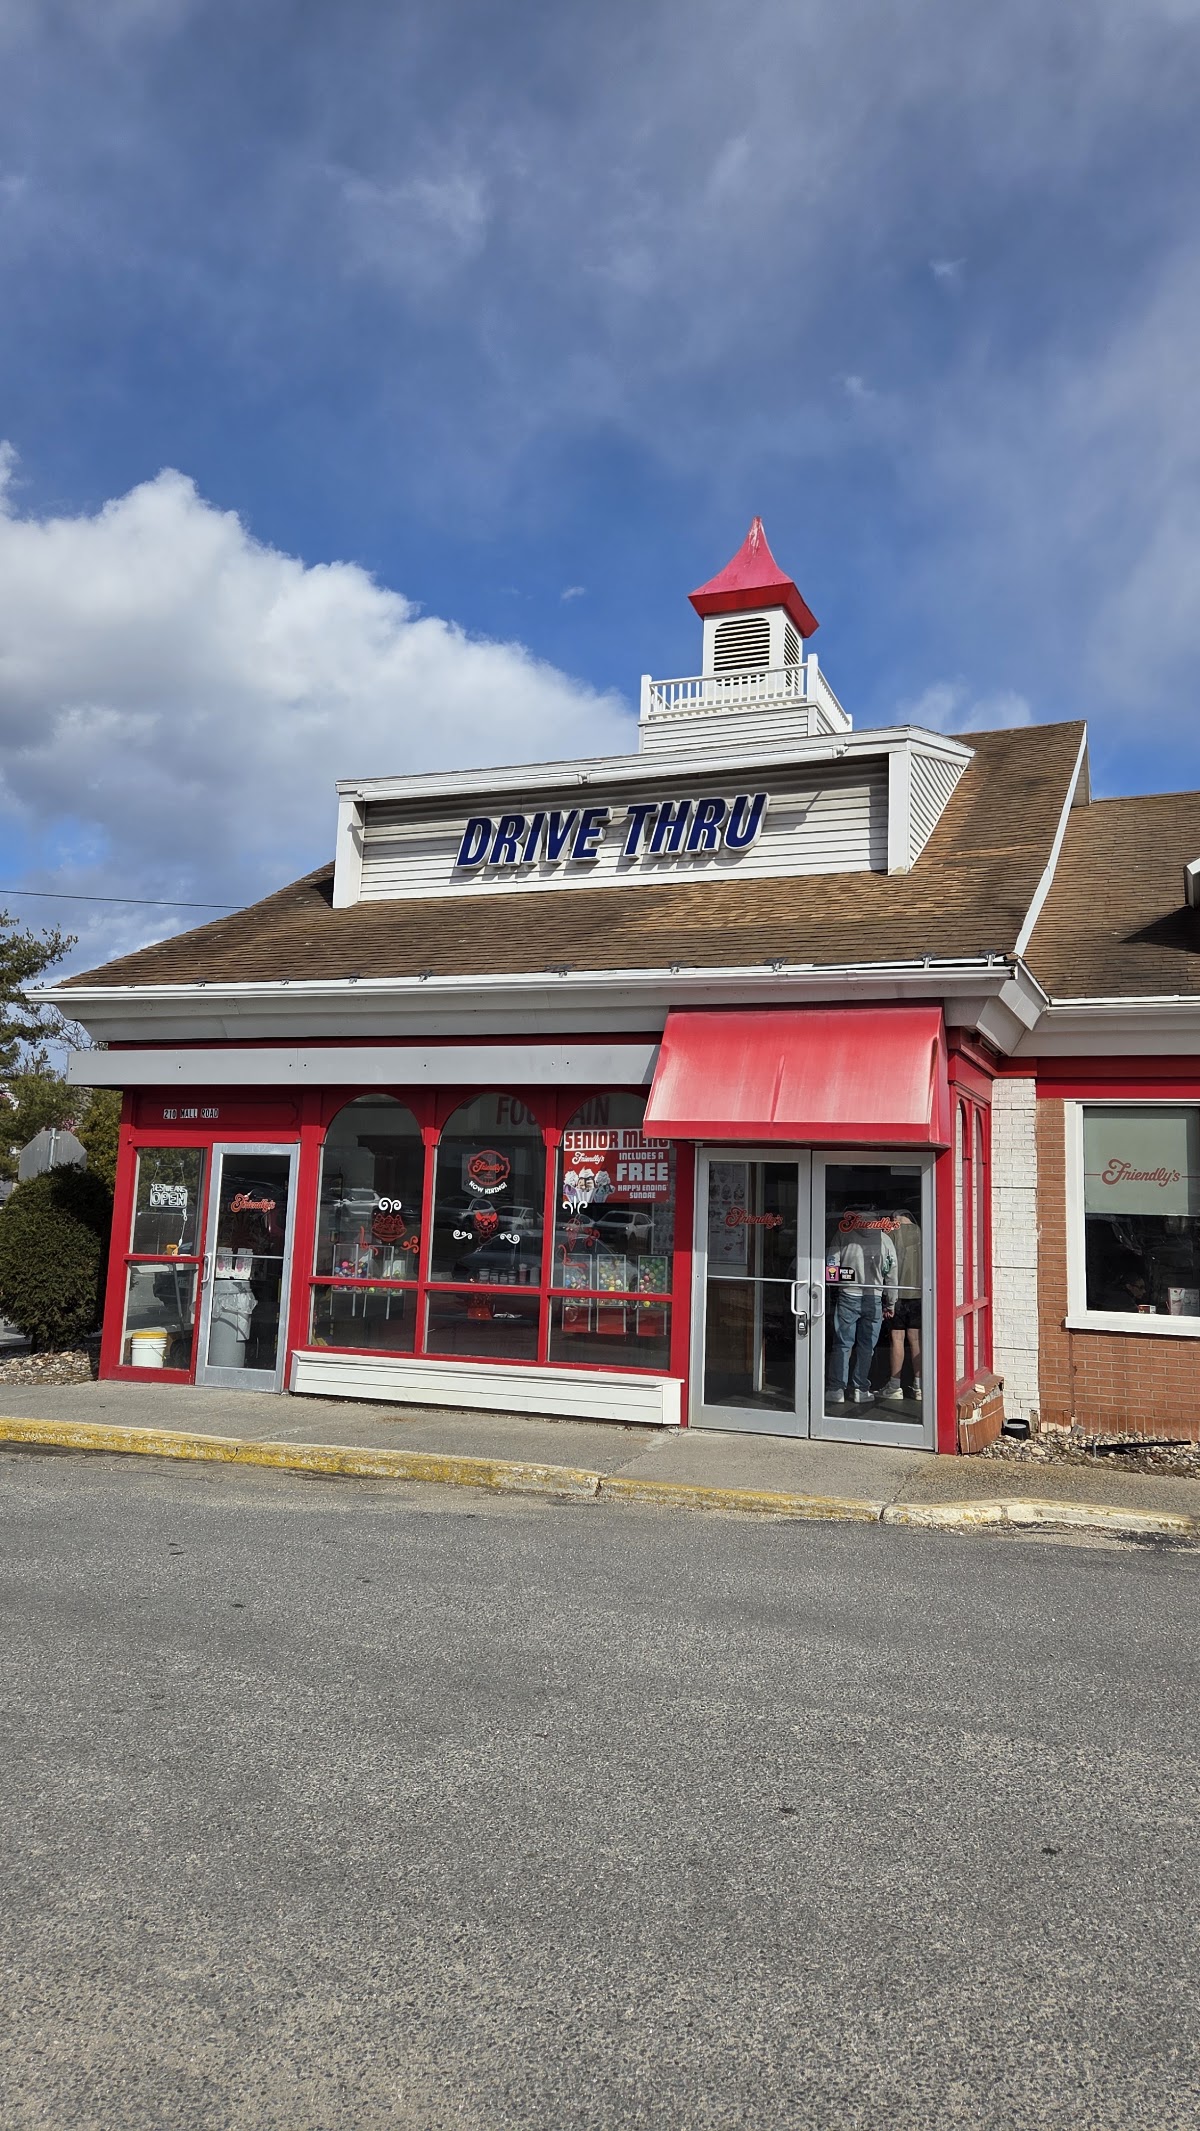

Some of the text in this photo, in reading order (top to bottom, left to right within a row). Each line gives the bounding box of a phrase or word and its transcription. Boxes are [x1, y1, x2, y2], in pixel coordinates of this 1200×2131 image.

[456, 792, 769, 867] DRIVE THRU
[164, 1108, 219, 1119] 210 MALL ROAD
[565, 1131, 619, 1149] SENIOR
[572, 1151, 605, 1165] Friendly's
[619, 1151, 664, 1161] INCLUDES A
[616, 1162, 669, 1182] FREE
[1101, 1158, 1181, 1188] Friendly's
[151, 1183, 165, 1192] YES
[469, 1181, 484, 1193] NOW
[152, 1191, 186, 1206] OPEN
[725, 1206, 783, 1229] Friendly's
[838, 1210, 901, 1234] Friendly's
